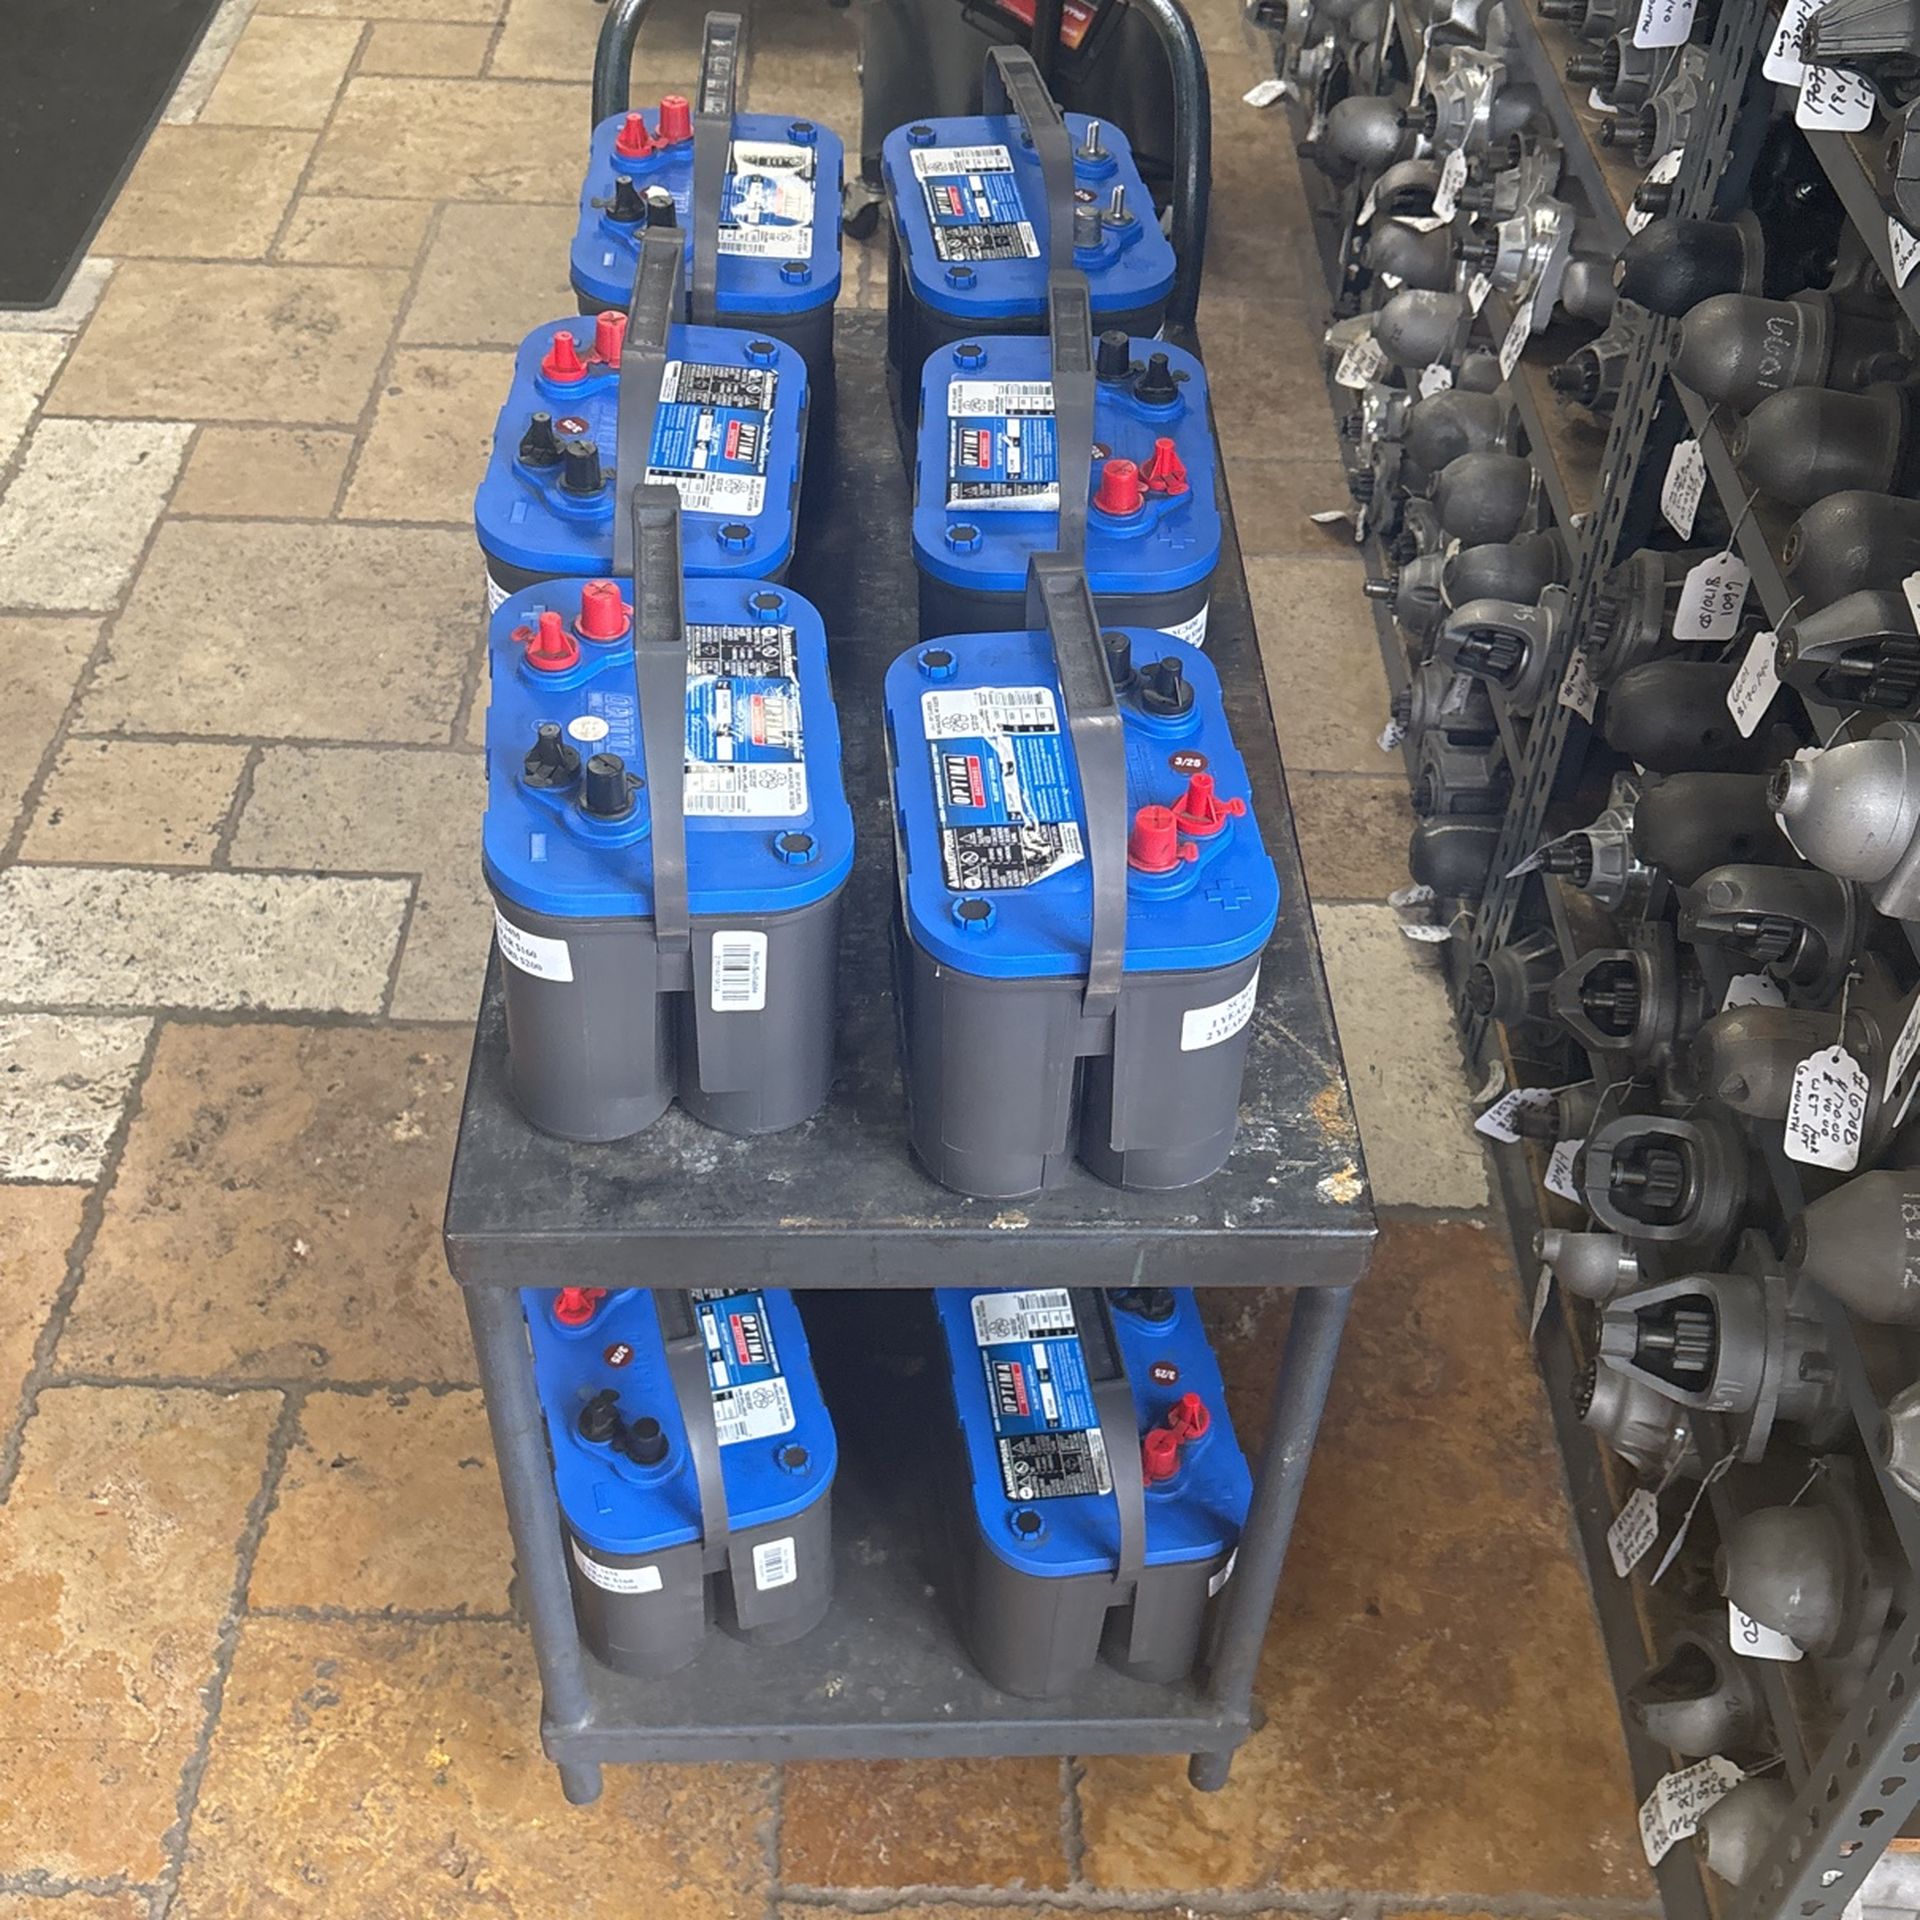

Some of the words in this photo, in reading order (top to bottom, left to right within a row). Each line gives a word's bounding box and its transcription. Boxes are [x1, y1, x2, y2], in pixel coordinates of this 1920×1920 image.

[736, 424, 758, 460] OPTIMA
[962, 431, 979, 467] OPTIMA
[948, 757, 971, 804] OPTIMA
[1175, 757, 1201, 767] 3/25
[1808, 1077, 1820, 1117] WET
[741, 1315, 765, 1362] OPTIMA
[998, 1364, 1018, 1413] OPTIMA
[1740, 1616, 1759, 1645] 50
